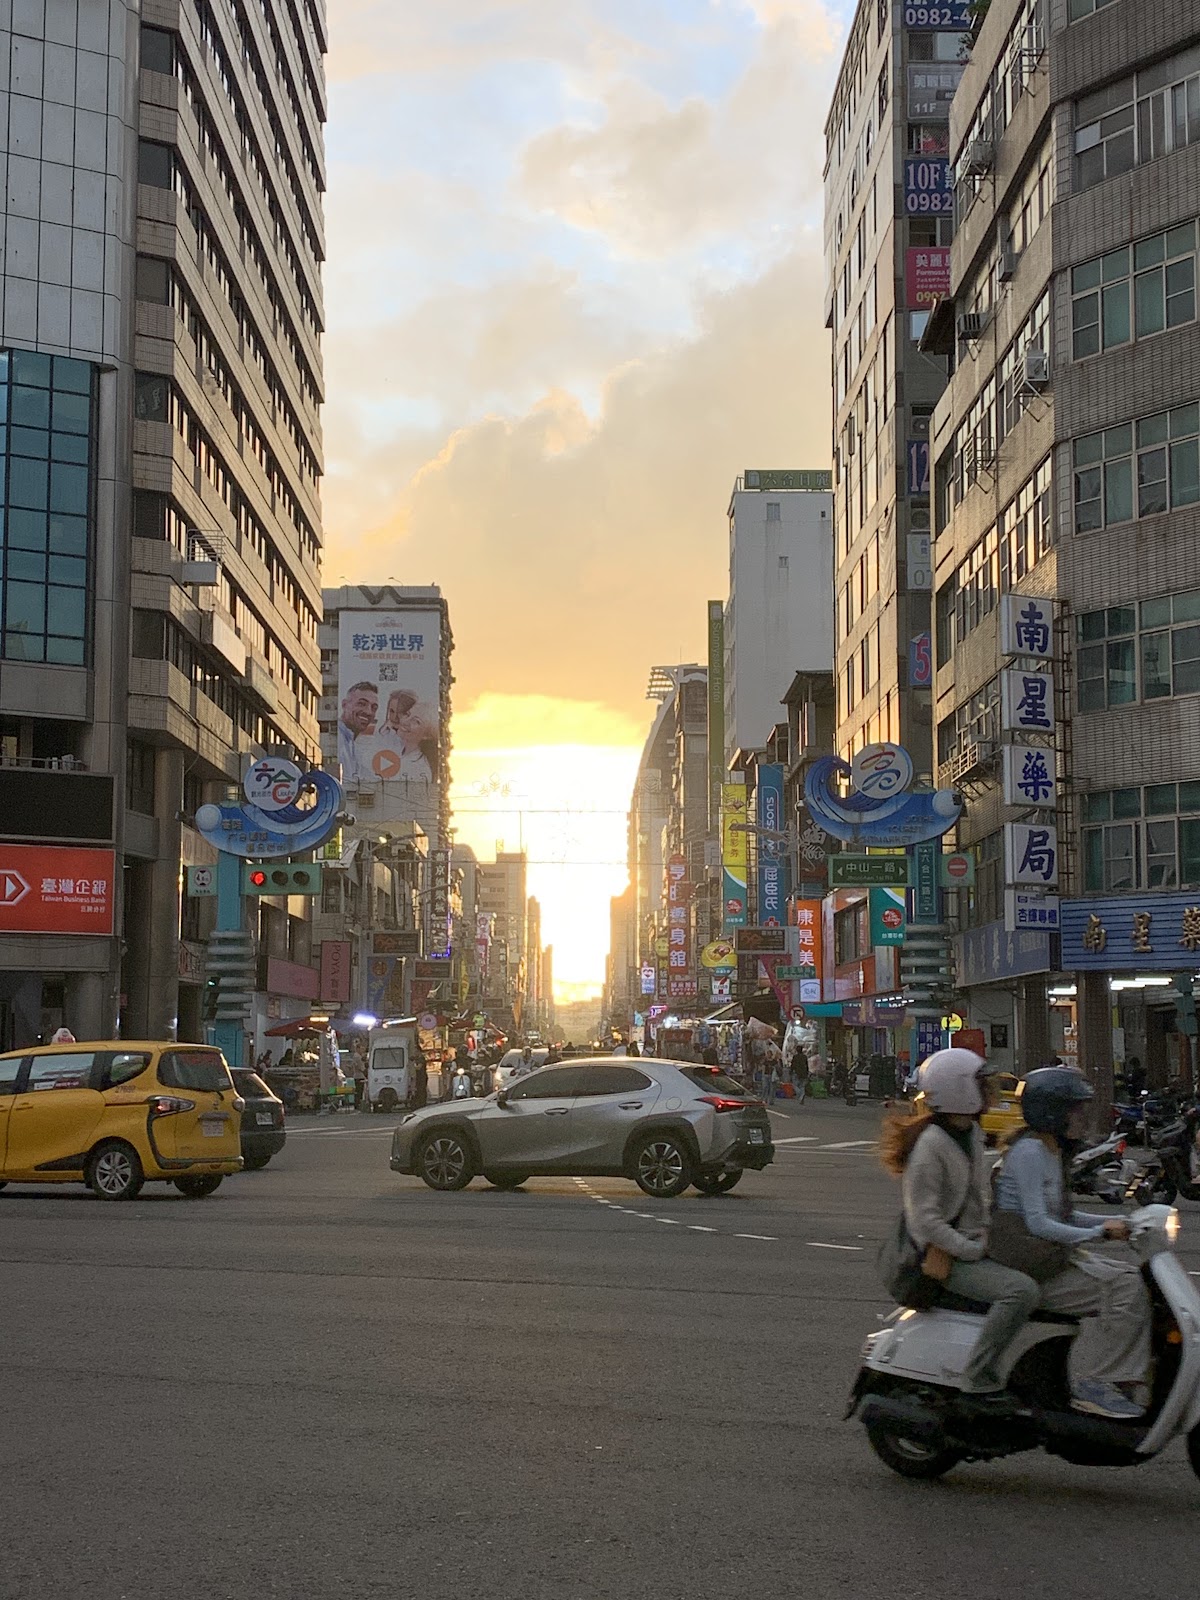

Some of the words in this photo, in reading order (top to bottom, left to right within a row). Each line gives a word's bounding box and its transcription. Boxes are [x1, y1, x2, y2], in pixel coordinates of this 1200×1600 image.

[914, 102, 937, 113] 11F
[907, 162, 941, 190] 10F
[352, 633, 424, 651] 乾淨世界
[1015, 601, 1055, 882] 南星藥局
[766, 796, 775, 850] wsons
[846, 862, 896, 873] 中山一路
[922, 853, 932, 896] 六合二路
[41, 878, 107, 895] 臺灣企銀
[764, 867, 778, 910] 屈臣氏
[797, 908, 815, 967] 康是美
[331, 945, 341, 975] POYA
